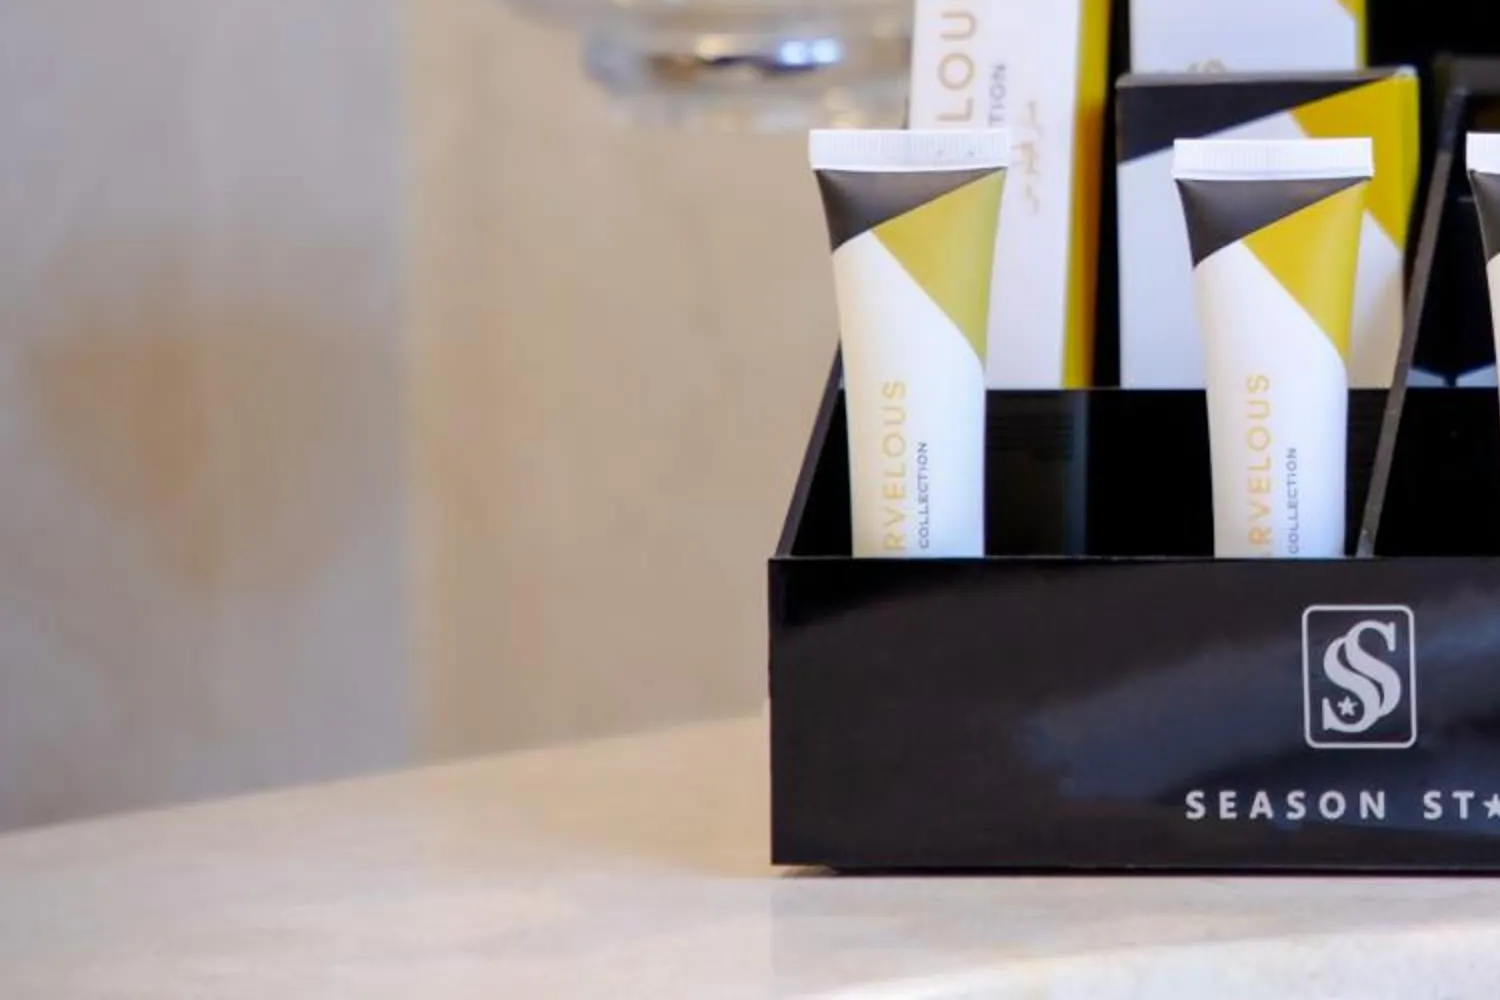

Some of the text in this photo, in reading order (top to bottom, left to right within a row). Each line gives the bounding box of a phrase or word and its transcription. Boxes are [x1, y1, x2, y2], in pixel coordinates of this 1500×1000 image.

[917, 441, 930, 550] COLLECTION
[1285, 447, 1299, 554] COLLECTION
[1185, 790, 1386, 820] SEASON
